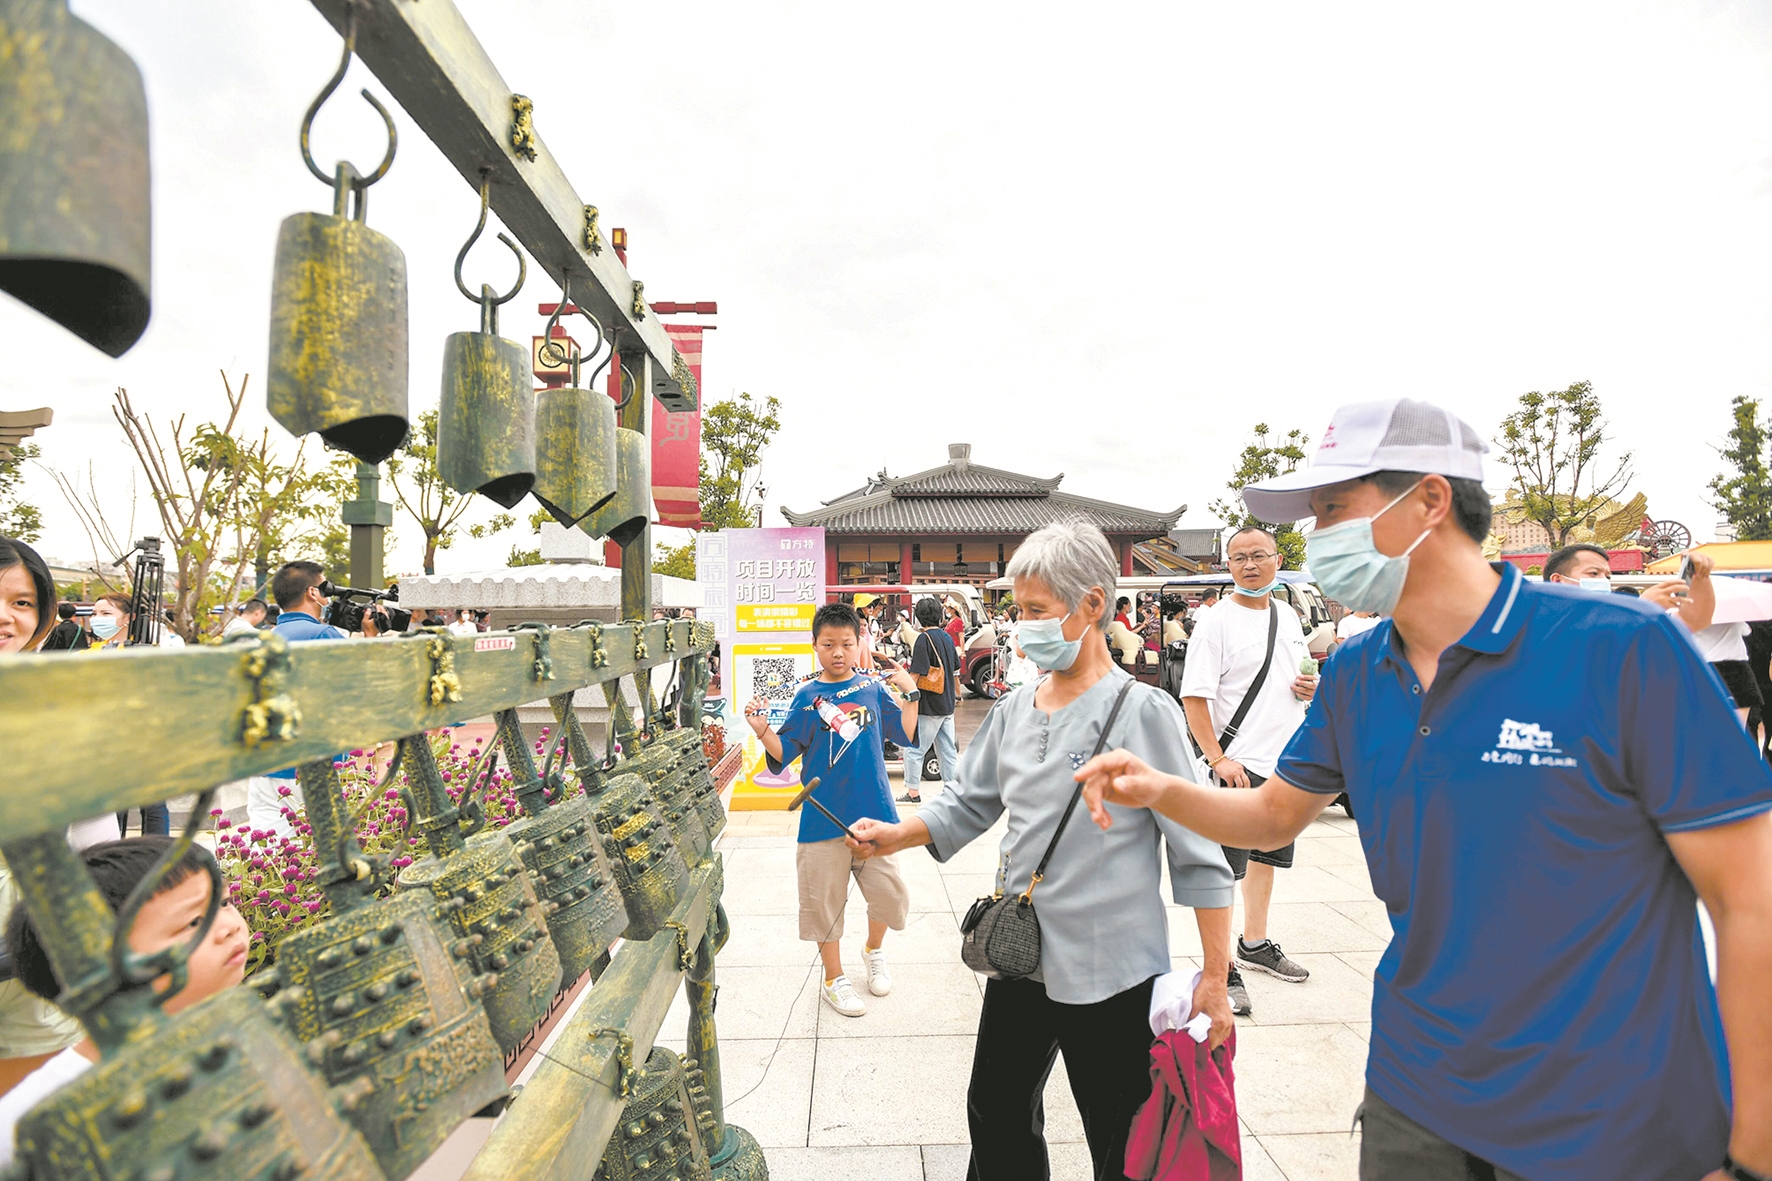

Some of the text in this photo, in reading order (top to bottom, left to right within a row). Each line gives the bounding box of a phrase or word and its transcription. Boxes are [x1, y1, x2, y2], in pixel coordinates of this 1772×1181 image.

[792, 539, 814, 550] 方特
[735, 558, 816, 579] 项目开放
[736, 582, 816, 602] 时间一览
